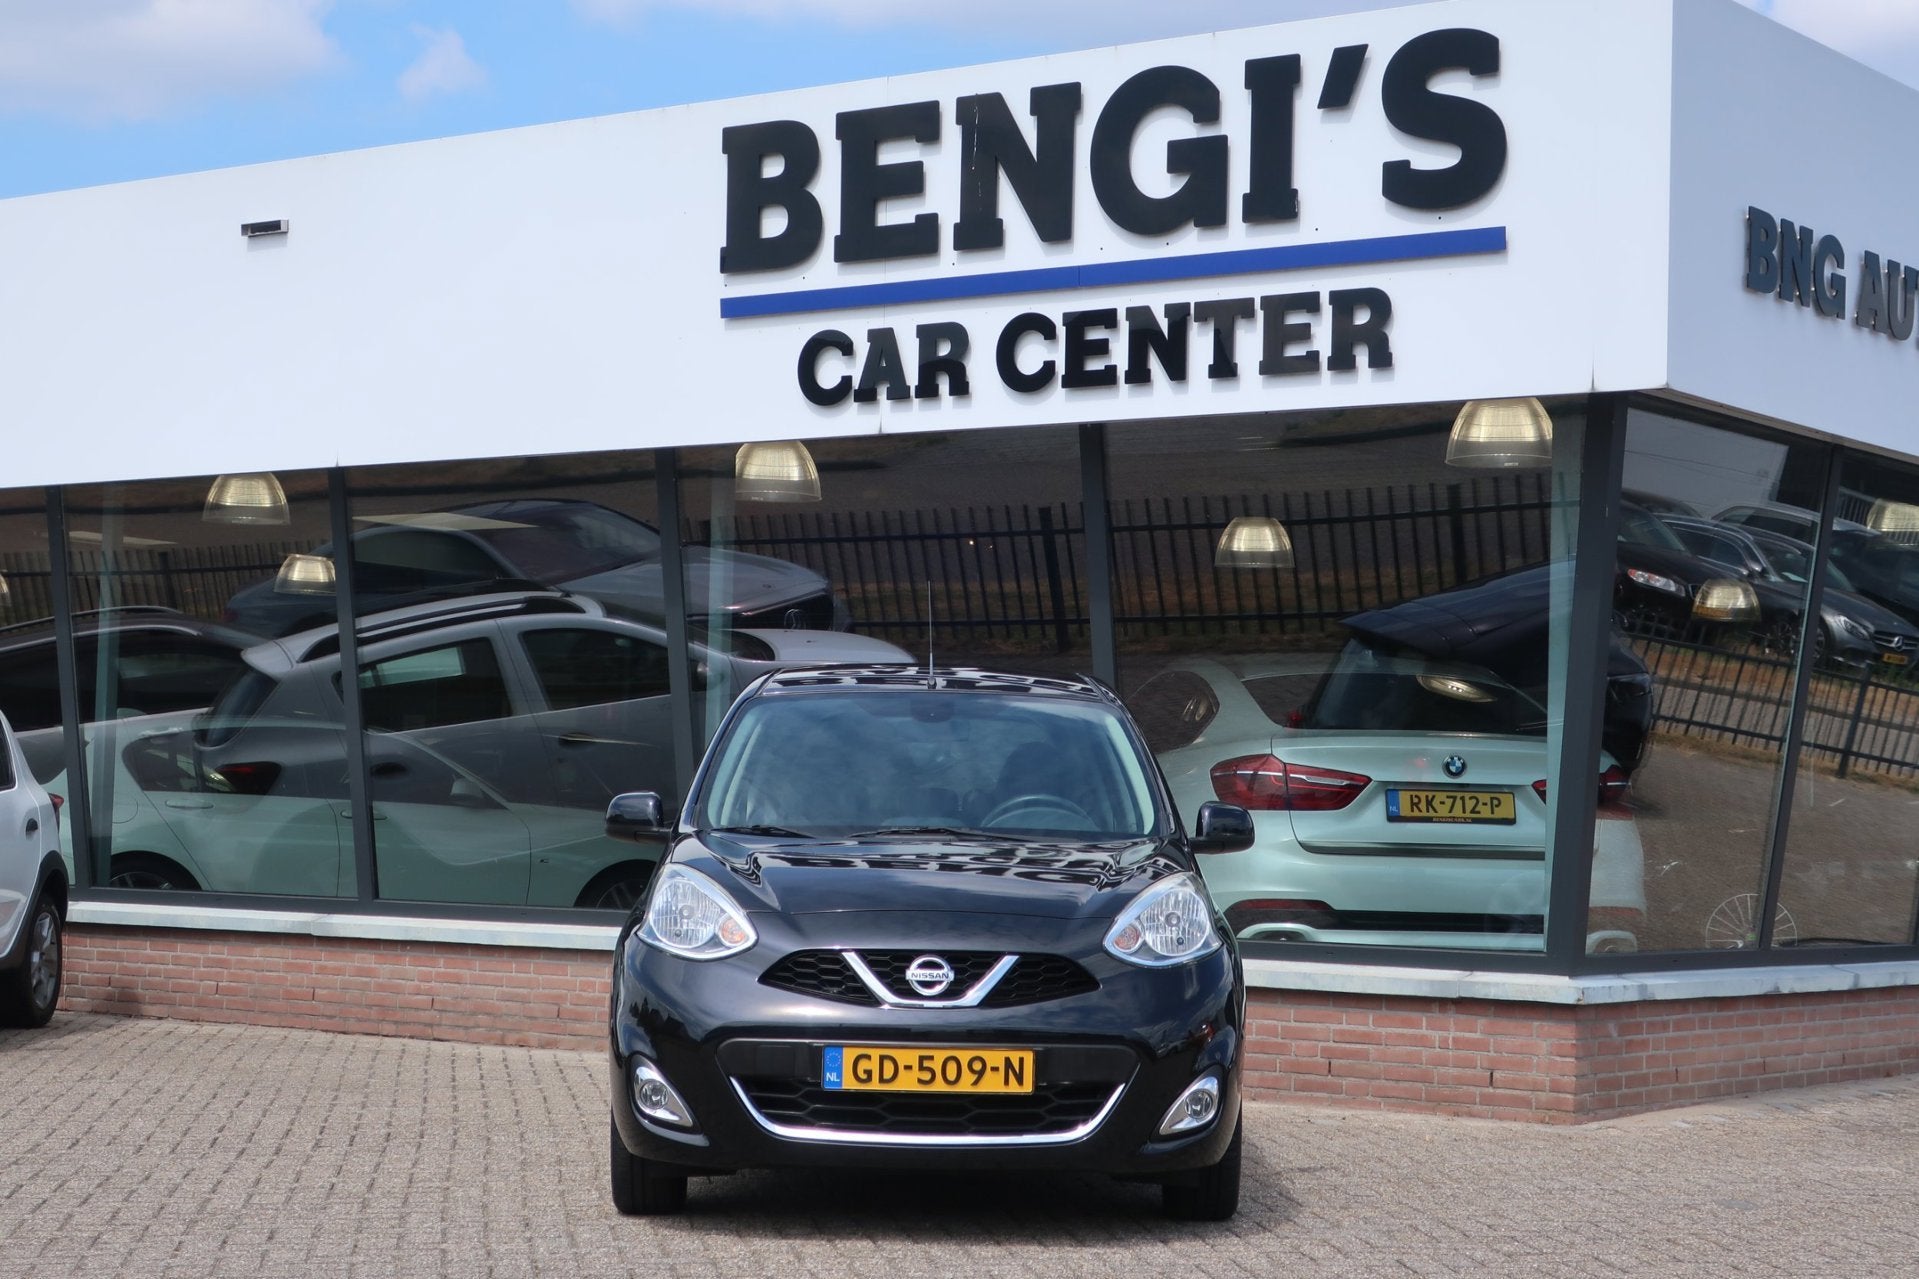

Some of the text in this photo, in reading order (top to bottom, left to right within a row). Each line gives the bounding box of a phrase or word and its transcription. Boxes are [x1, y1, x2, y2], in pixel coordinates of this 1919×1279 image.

[720, 27, 1508, 274] BENGI'S
[1746, 205, 1919, 351] BNG AU
[798, 287, 1393, 405] CAR CENTER
[1409, 794, 1502, 815] RK-712-P
[826, 1072, 840, 1082] NL
[851, 1053, 1025, 1087] GD-509-N
